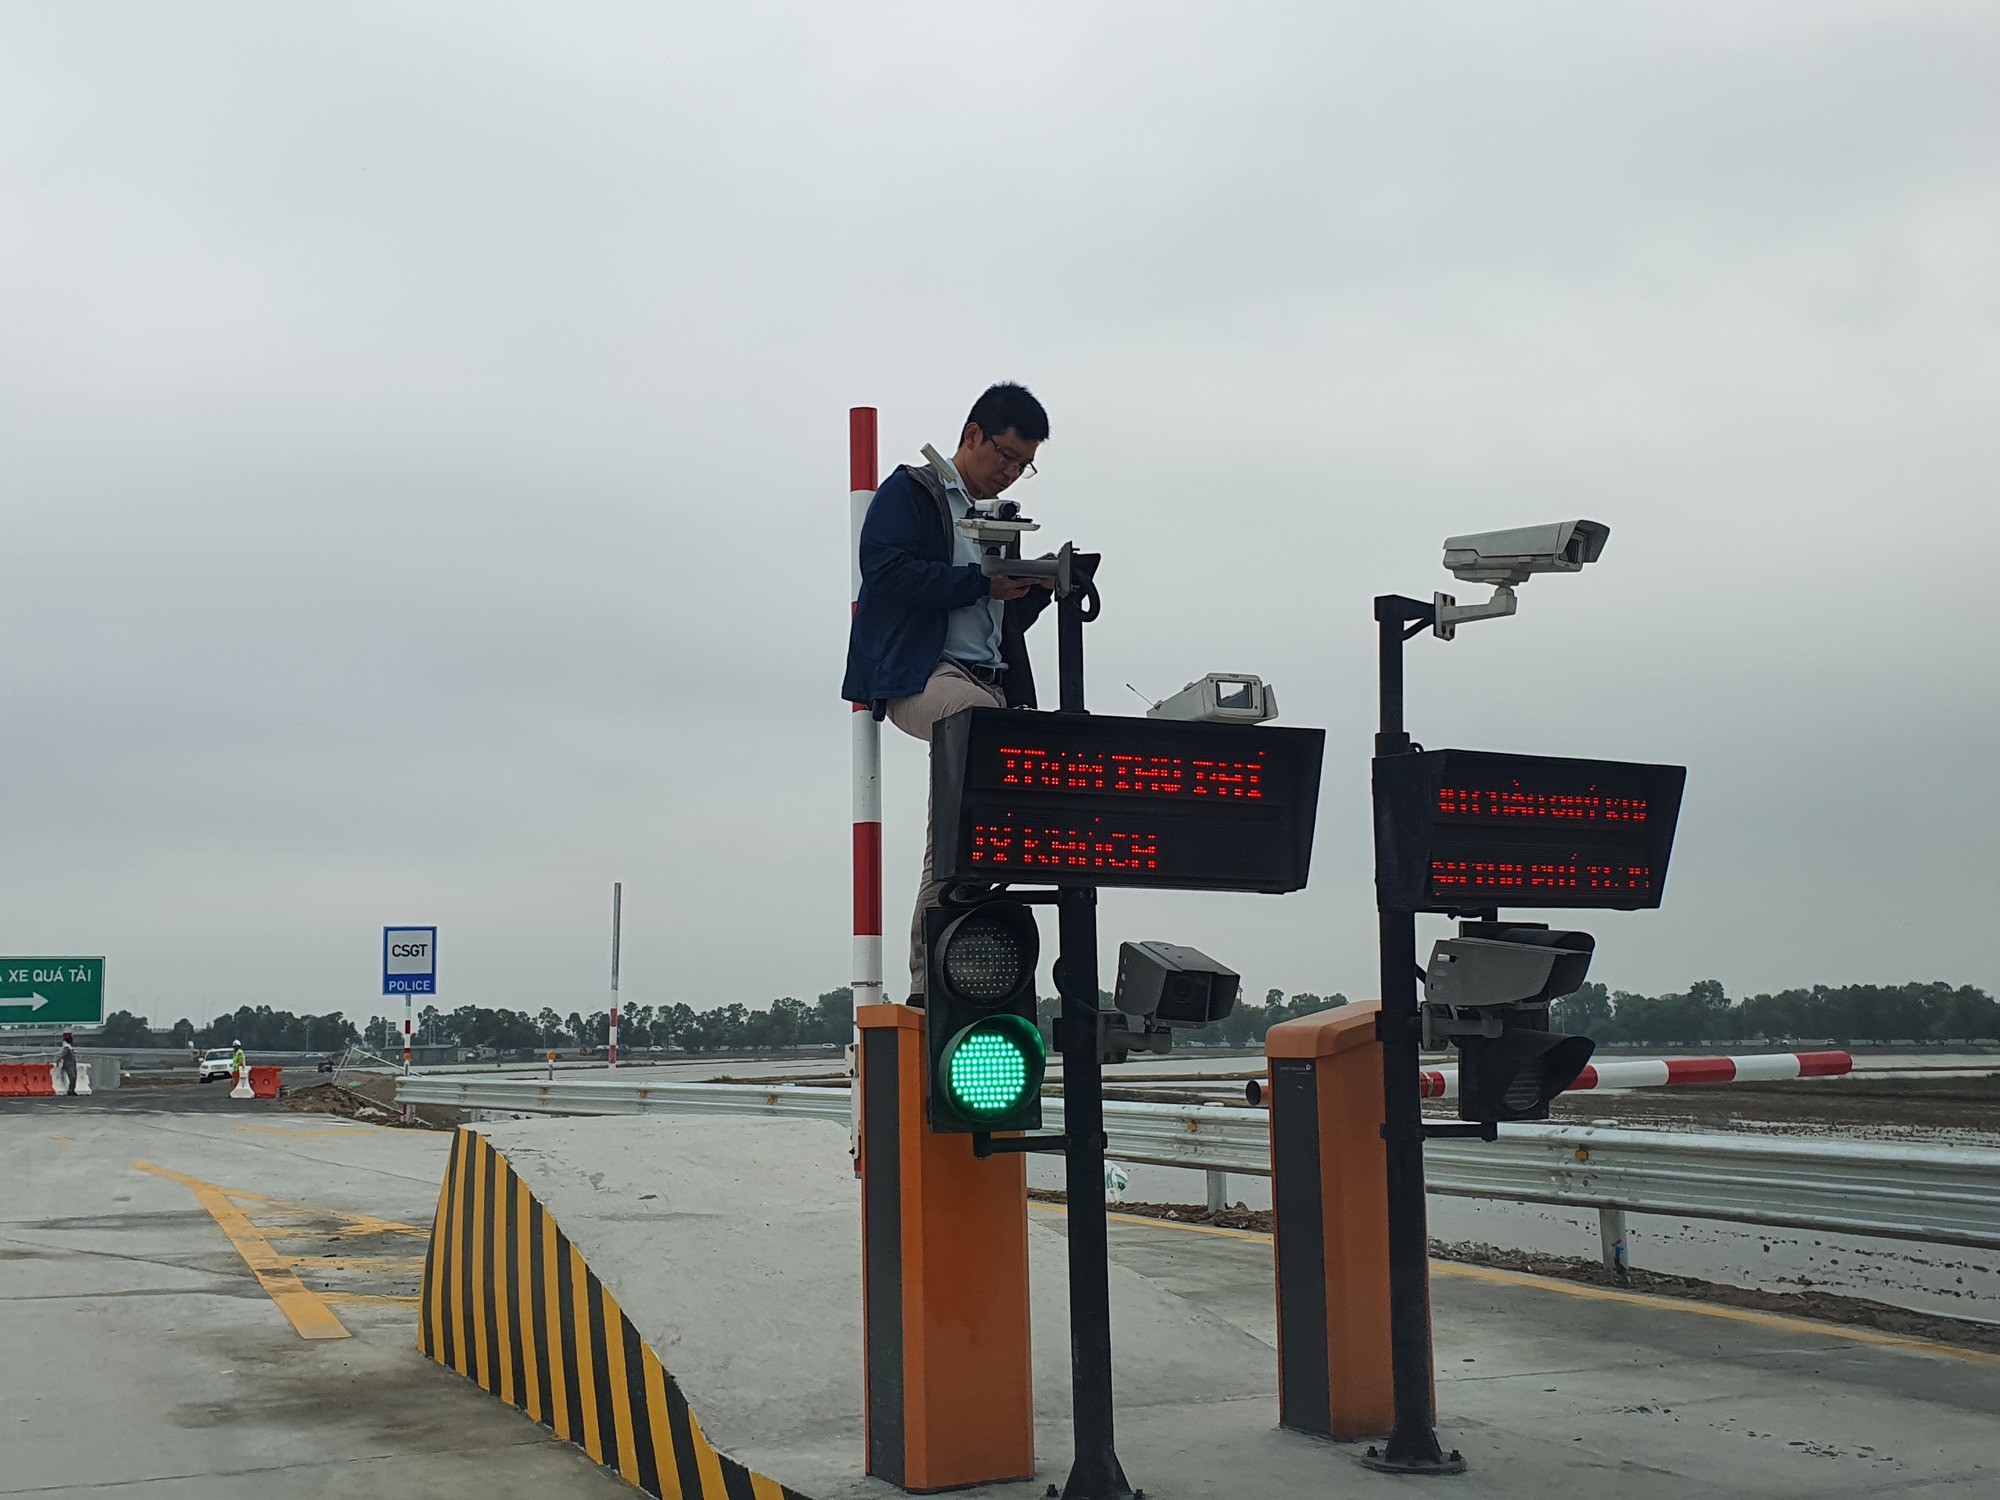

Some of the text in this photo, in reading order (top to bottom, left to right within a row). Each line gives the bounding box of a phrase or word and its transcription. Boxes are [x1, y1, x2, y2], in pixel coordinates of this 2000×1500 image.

[392, 944, 428, 957] CSGT
[8, 969, 29, 982] XE
[32, 966, 64, 982] QUÁ
[68, 964, 92, 982] TẢI
[388, 980, 431, 991] POLICE
